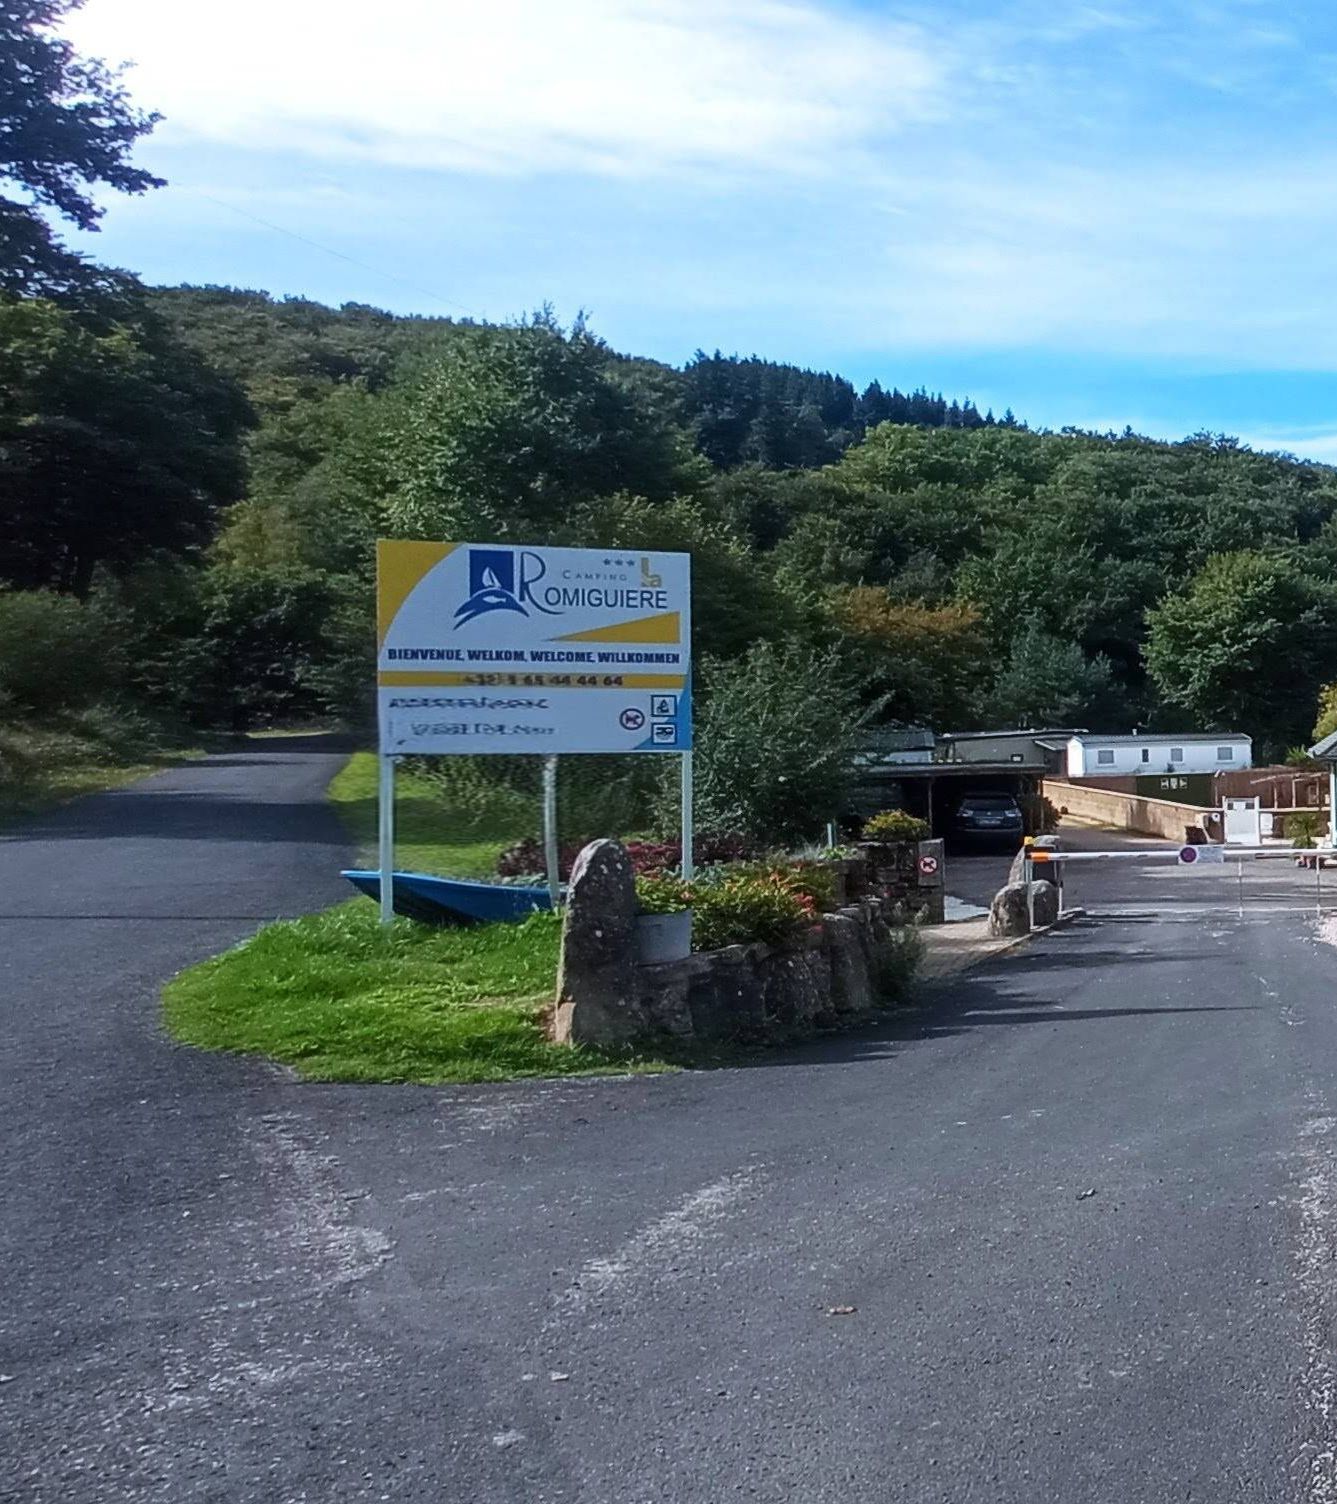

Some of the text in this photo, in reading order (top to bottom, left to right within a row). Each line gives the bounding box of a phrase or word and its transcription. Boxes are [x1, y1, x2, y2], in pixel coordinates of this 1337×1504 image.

[562, 569, 628, 582] CAMPING
[519, 551, 668, 615] ROMIGUIERE
[597, 651, 680, 664] WILLKOMMEN
